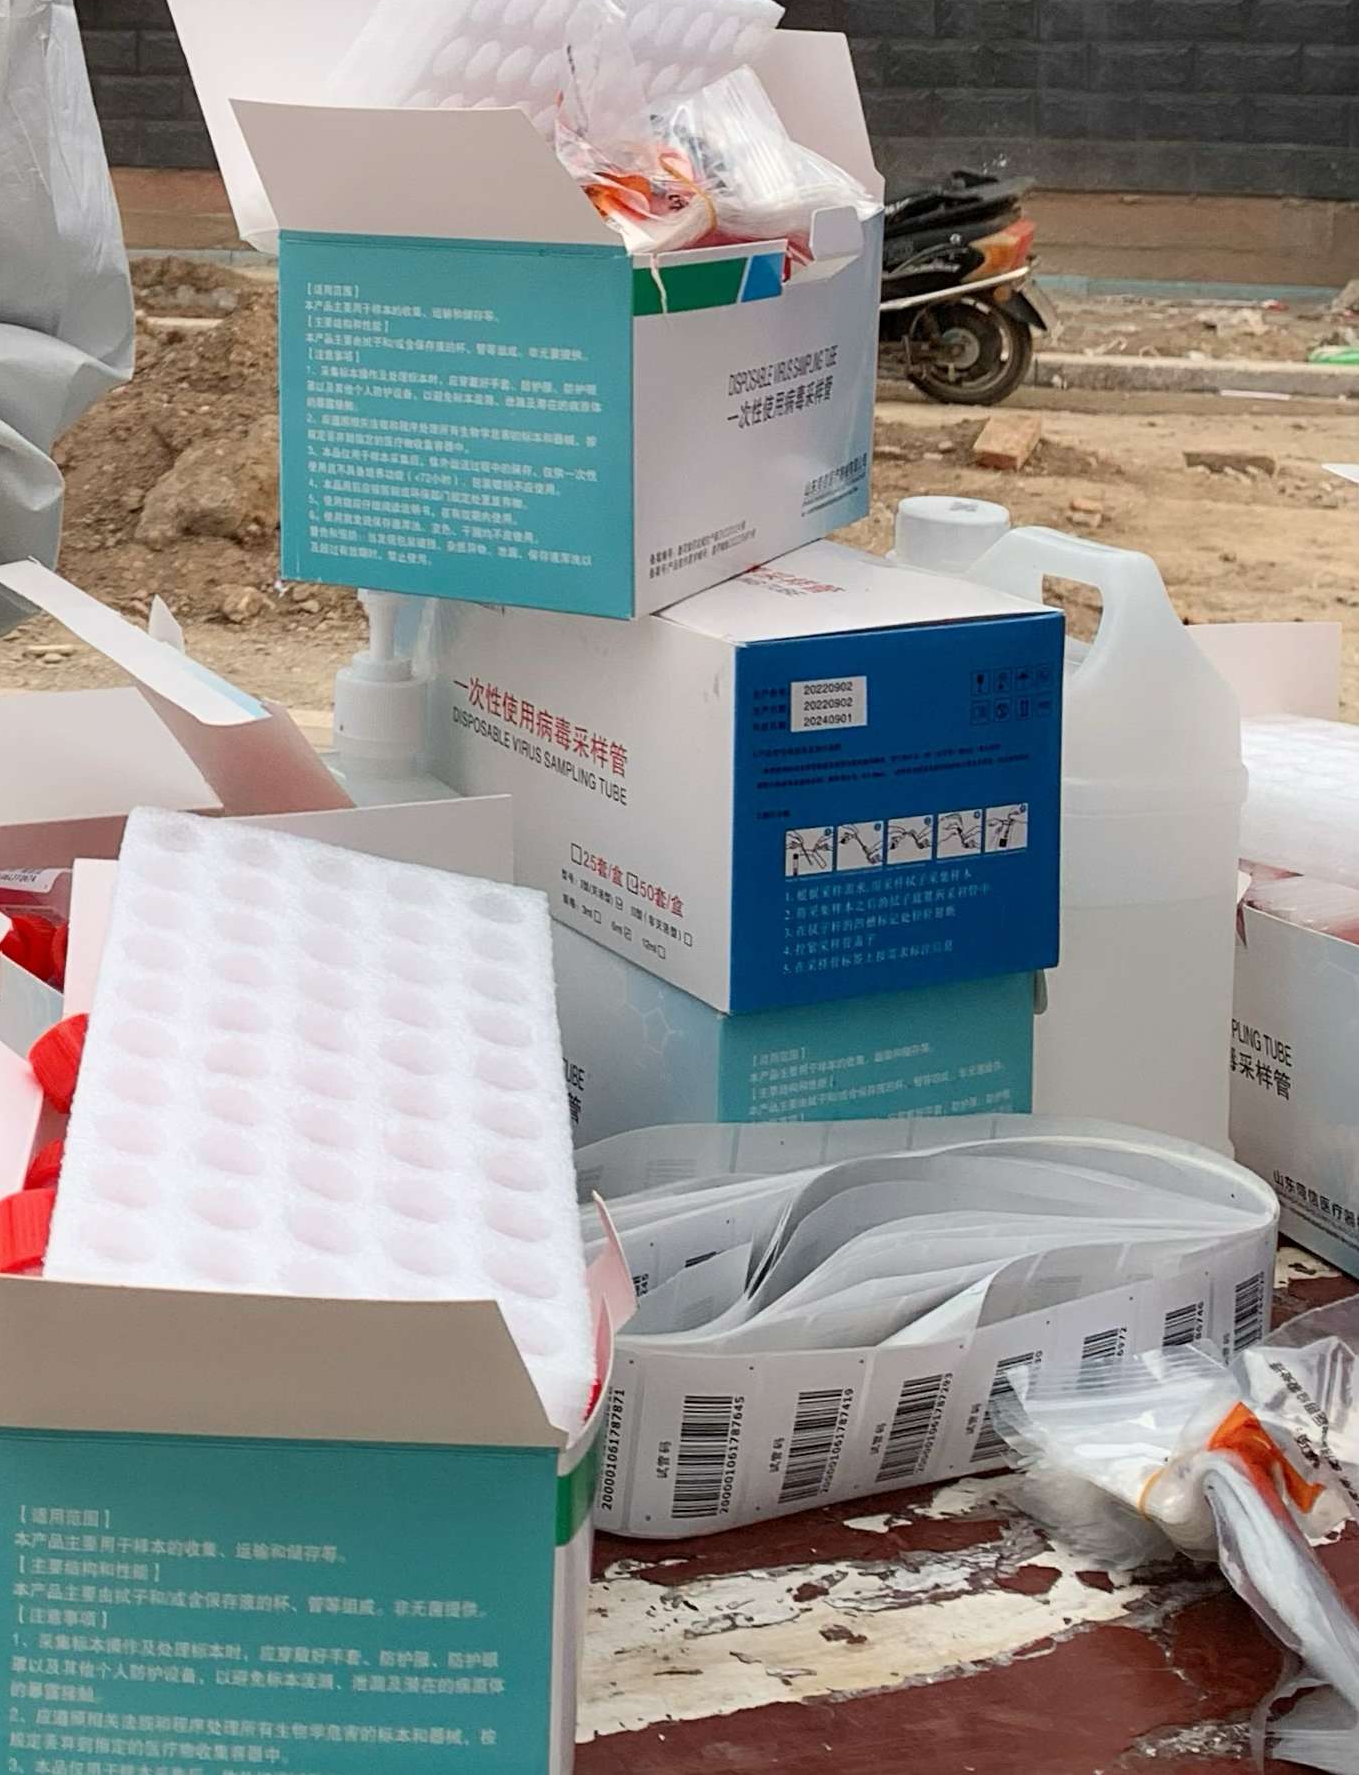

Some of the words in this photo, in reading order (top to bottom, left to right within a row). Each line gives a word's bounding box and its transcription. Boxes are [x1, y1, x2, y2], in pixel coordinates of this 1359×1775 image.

[727, 376, 833, 428] 一次性使用病毒采样管
[803, 681, 853, 696] 20220902
[803, 697, 853, 712] 20220902
[453, 677, 628, 778] 一次性使用病毒采样管
[803, 713, 853, 728] 20240901
[453, 706, 510, 749] DISPOSABLE
[512, 735, 543, 764] VIRUS
[544, 749, 596, 791] SAMPLING
[597, 777, 628, 806] TUBE
[582, 850, 623, 887] 25套/盒
[640, 881, 683, 918] 50套/盒
[1232, 1017, 1261, 1052] PLING
[1263, 1033, 1292, 1067] TUBE
[601, 1389, 626, 1511] 200001061787871
[657, 1441, 672, 1479] 试管码
[719, 1395, 745, 1515] 200001061787645
[769, 1436, 785, 1474] 试管码
[820, 1388, 854, 1494] 200001061787419
